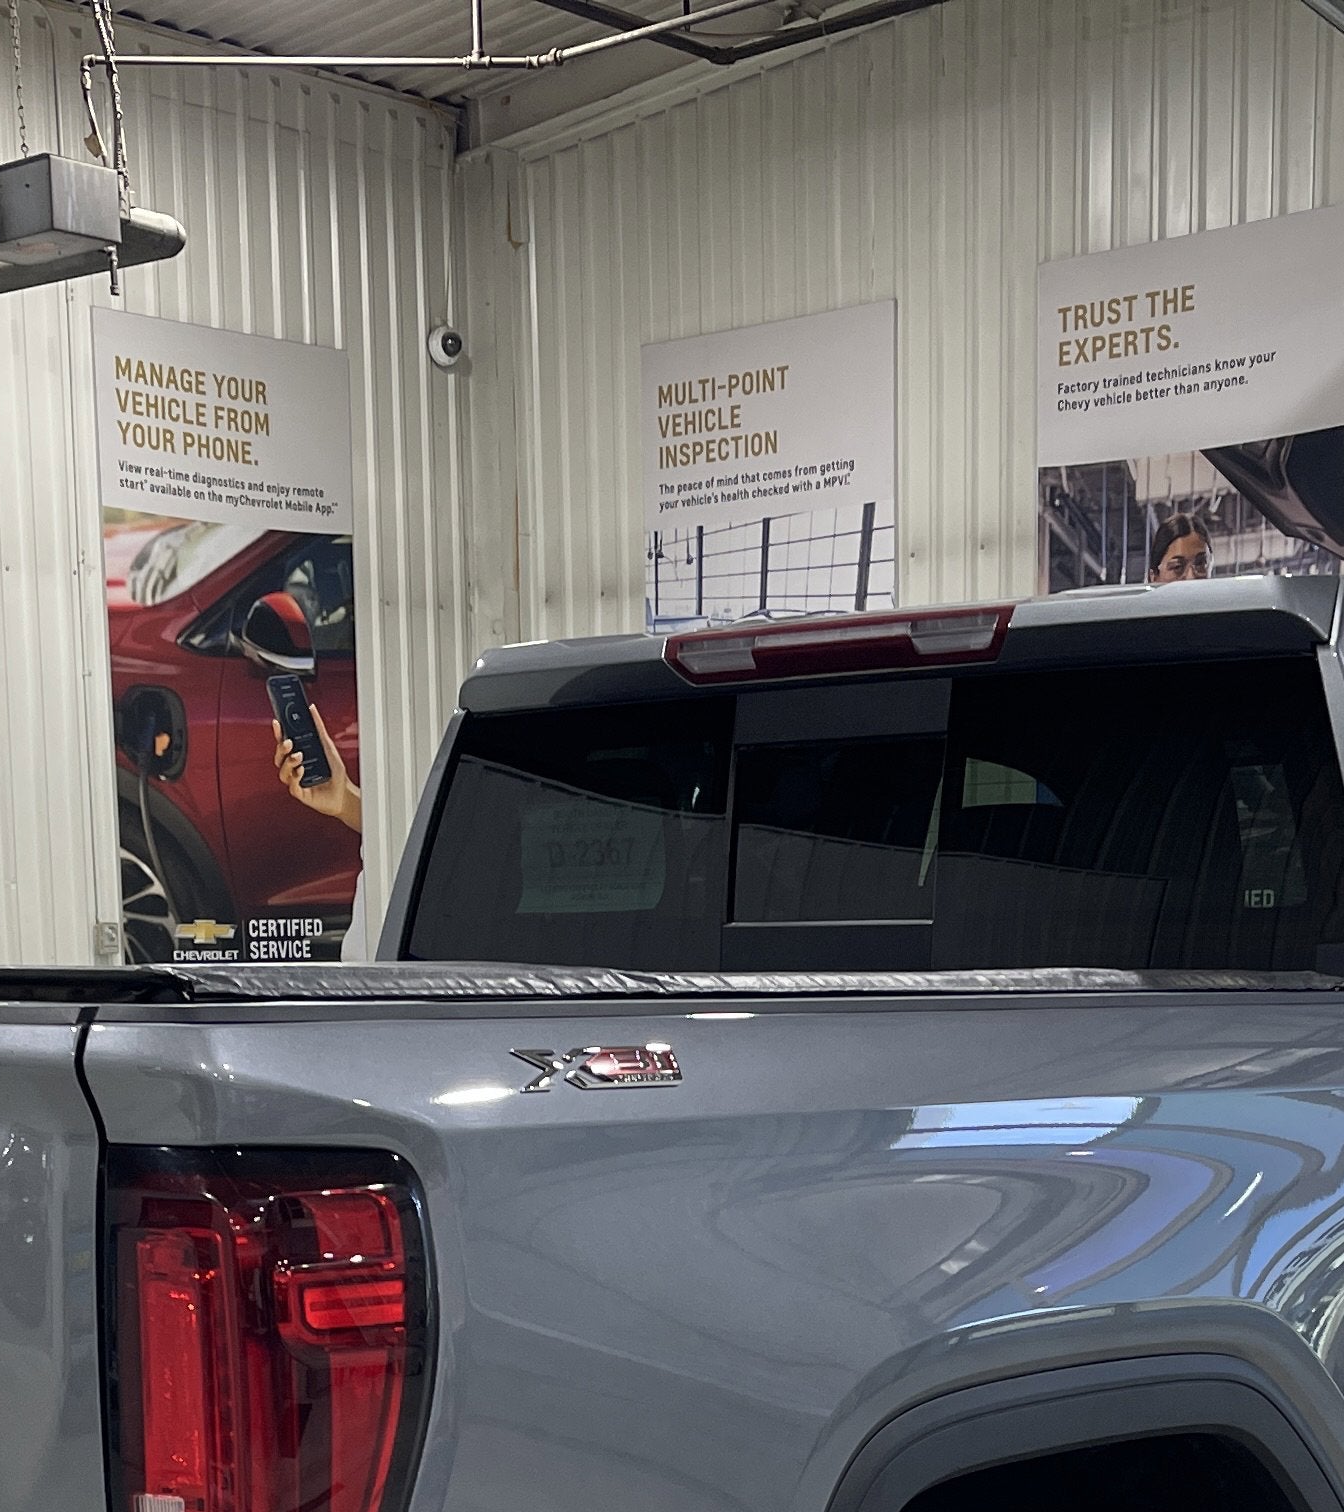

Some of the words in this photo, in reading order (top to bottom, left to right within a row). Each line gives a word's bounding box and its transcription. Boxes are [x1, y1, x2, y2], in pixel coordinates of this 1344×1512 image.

[1058, 294, 1138, 333] TRUST
[1145, 284, 1196, 317] THE
[1058, 324, 1180, 367] EXPERTS.
[114, 355, 207, 396] MANAGE
[212, 373, 268, 405] YOUR
[658, 365, 790, 409] MULTI-POINT
[1057, 377, 1100, 395] Factory
[1102, 372, 1143, 389] trained
[1146, 362, 1212, 383] technicians
[1214, 356, 1247, 372] know
[1249, 351, 1277, 367] your
[115, 387, 207, 428] VEHICLE
[213, 405, 270, 436] FROM
[1057, 396, 1091, 412] Chevy
[1093, 390, 1132, 408] vehicle
[1136, 386, 1171, 402] better
[1174, 381, 1200, 396] than
[1203, 375, 1249, 394] anyone.
[657, 404, 742, 439] VEHICLE
[116, 420, 176, 454] YOUR
[182, 431, 259, 466] PHONE.
[659, 430, 778, 470] INSPECTION
[118, 460, 142, 475] View
[144, 465, 191, 483] real-time
[192, 472, 246, 490] diagnostics
[247, 478, 264, 493] and
[266, 481, 290, 498] enjoy
[292, 487, 324, 498] remote
[659, 483, 675, 496] The
[677, 480, 703, 497] peace
[705, 477, 715, 490] of
[716, 474, 739, 488] mind
[741, 472, 761, 486] that
[762, 468, 793, 482] comes
[794, 465, 818, 478] from
[819, 458, 855, 477] getting
[659, 499, 680, 513] your
[681, 491, 719, 509] vehicle's
[721, 488, 750, 504] health
[752, 484, 790, 500] checked
[791, 480, 813, 494] with
[815, 479, 821, 490] a
[150, 482, 192, 500] available
[194, 490, 206, 501] on
[208, 489, 223, 503] the
[225, 492, 283, 511] myChevrolet
[285, 499, 313, 513] Mobile
[248, 918, 323, 938] CERTIFIED
[173, 950, 239, 961] CHEVROLET
[249, 940, 312, 960] SERVICE
